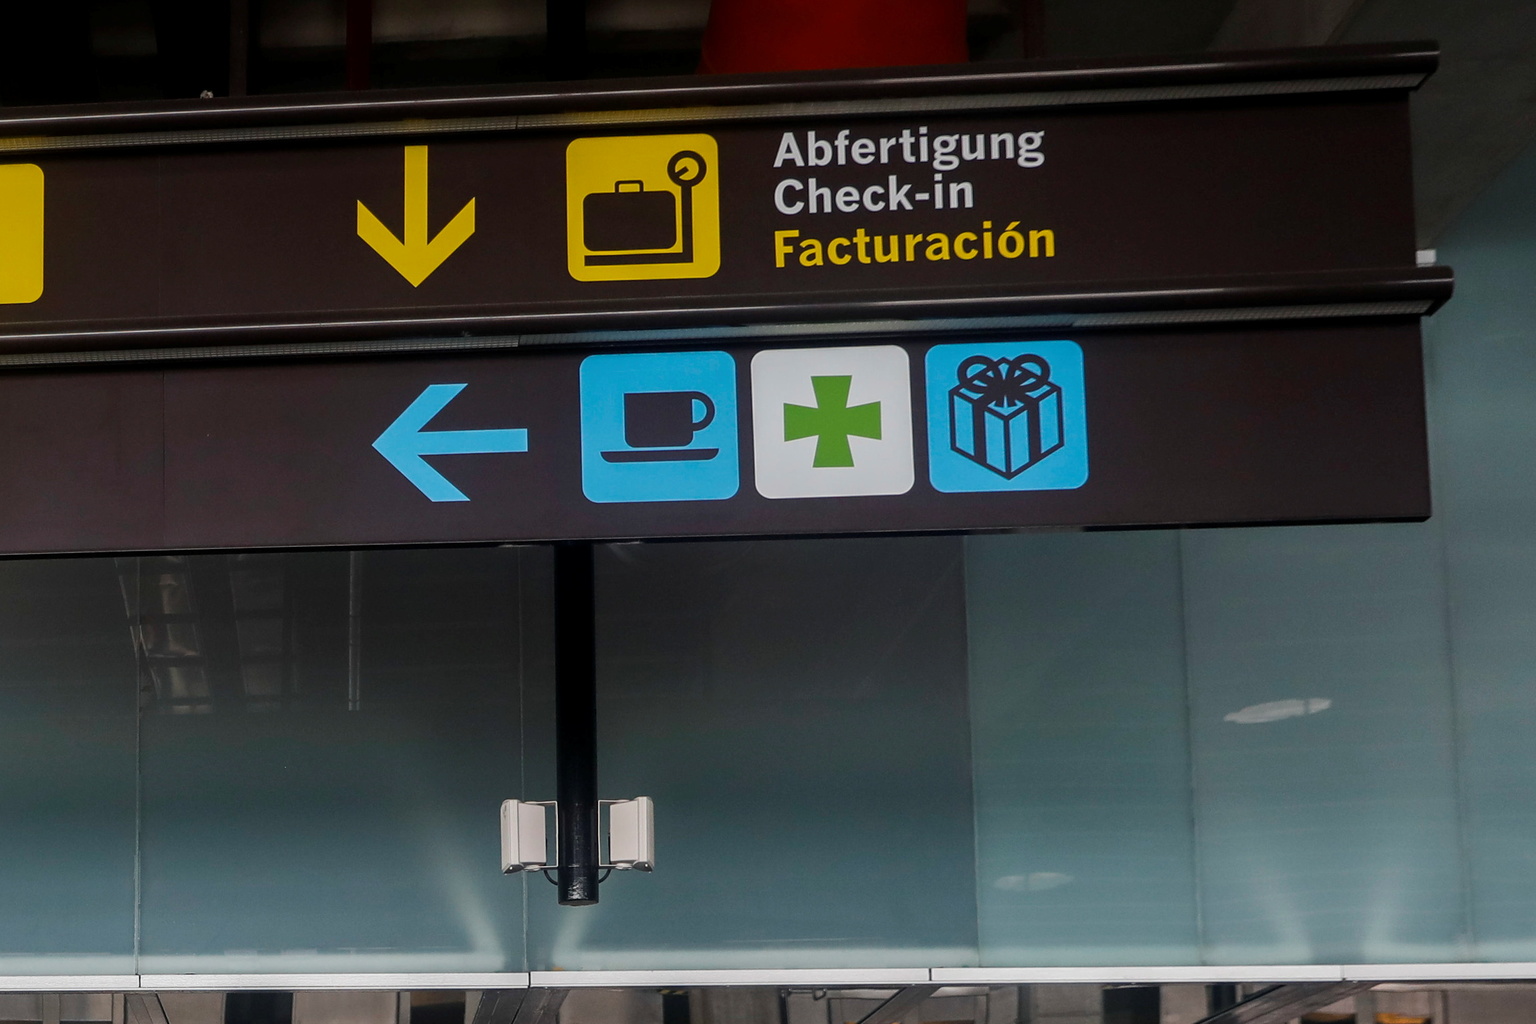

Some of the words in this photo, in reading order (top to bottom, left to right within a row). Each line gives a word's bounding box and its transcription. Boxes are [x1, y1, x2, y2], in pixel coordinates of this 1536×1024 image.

[773, 126, 1046, 172] Abfertigung
[773, 173, 975, 215] Check-in
[773, 220, 1056, 268] Facturación
